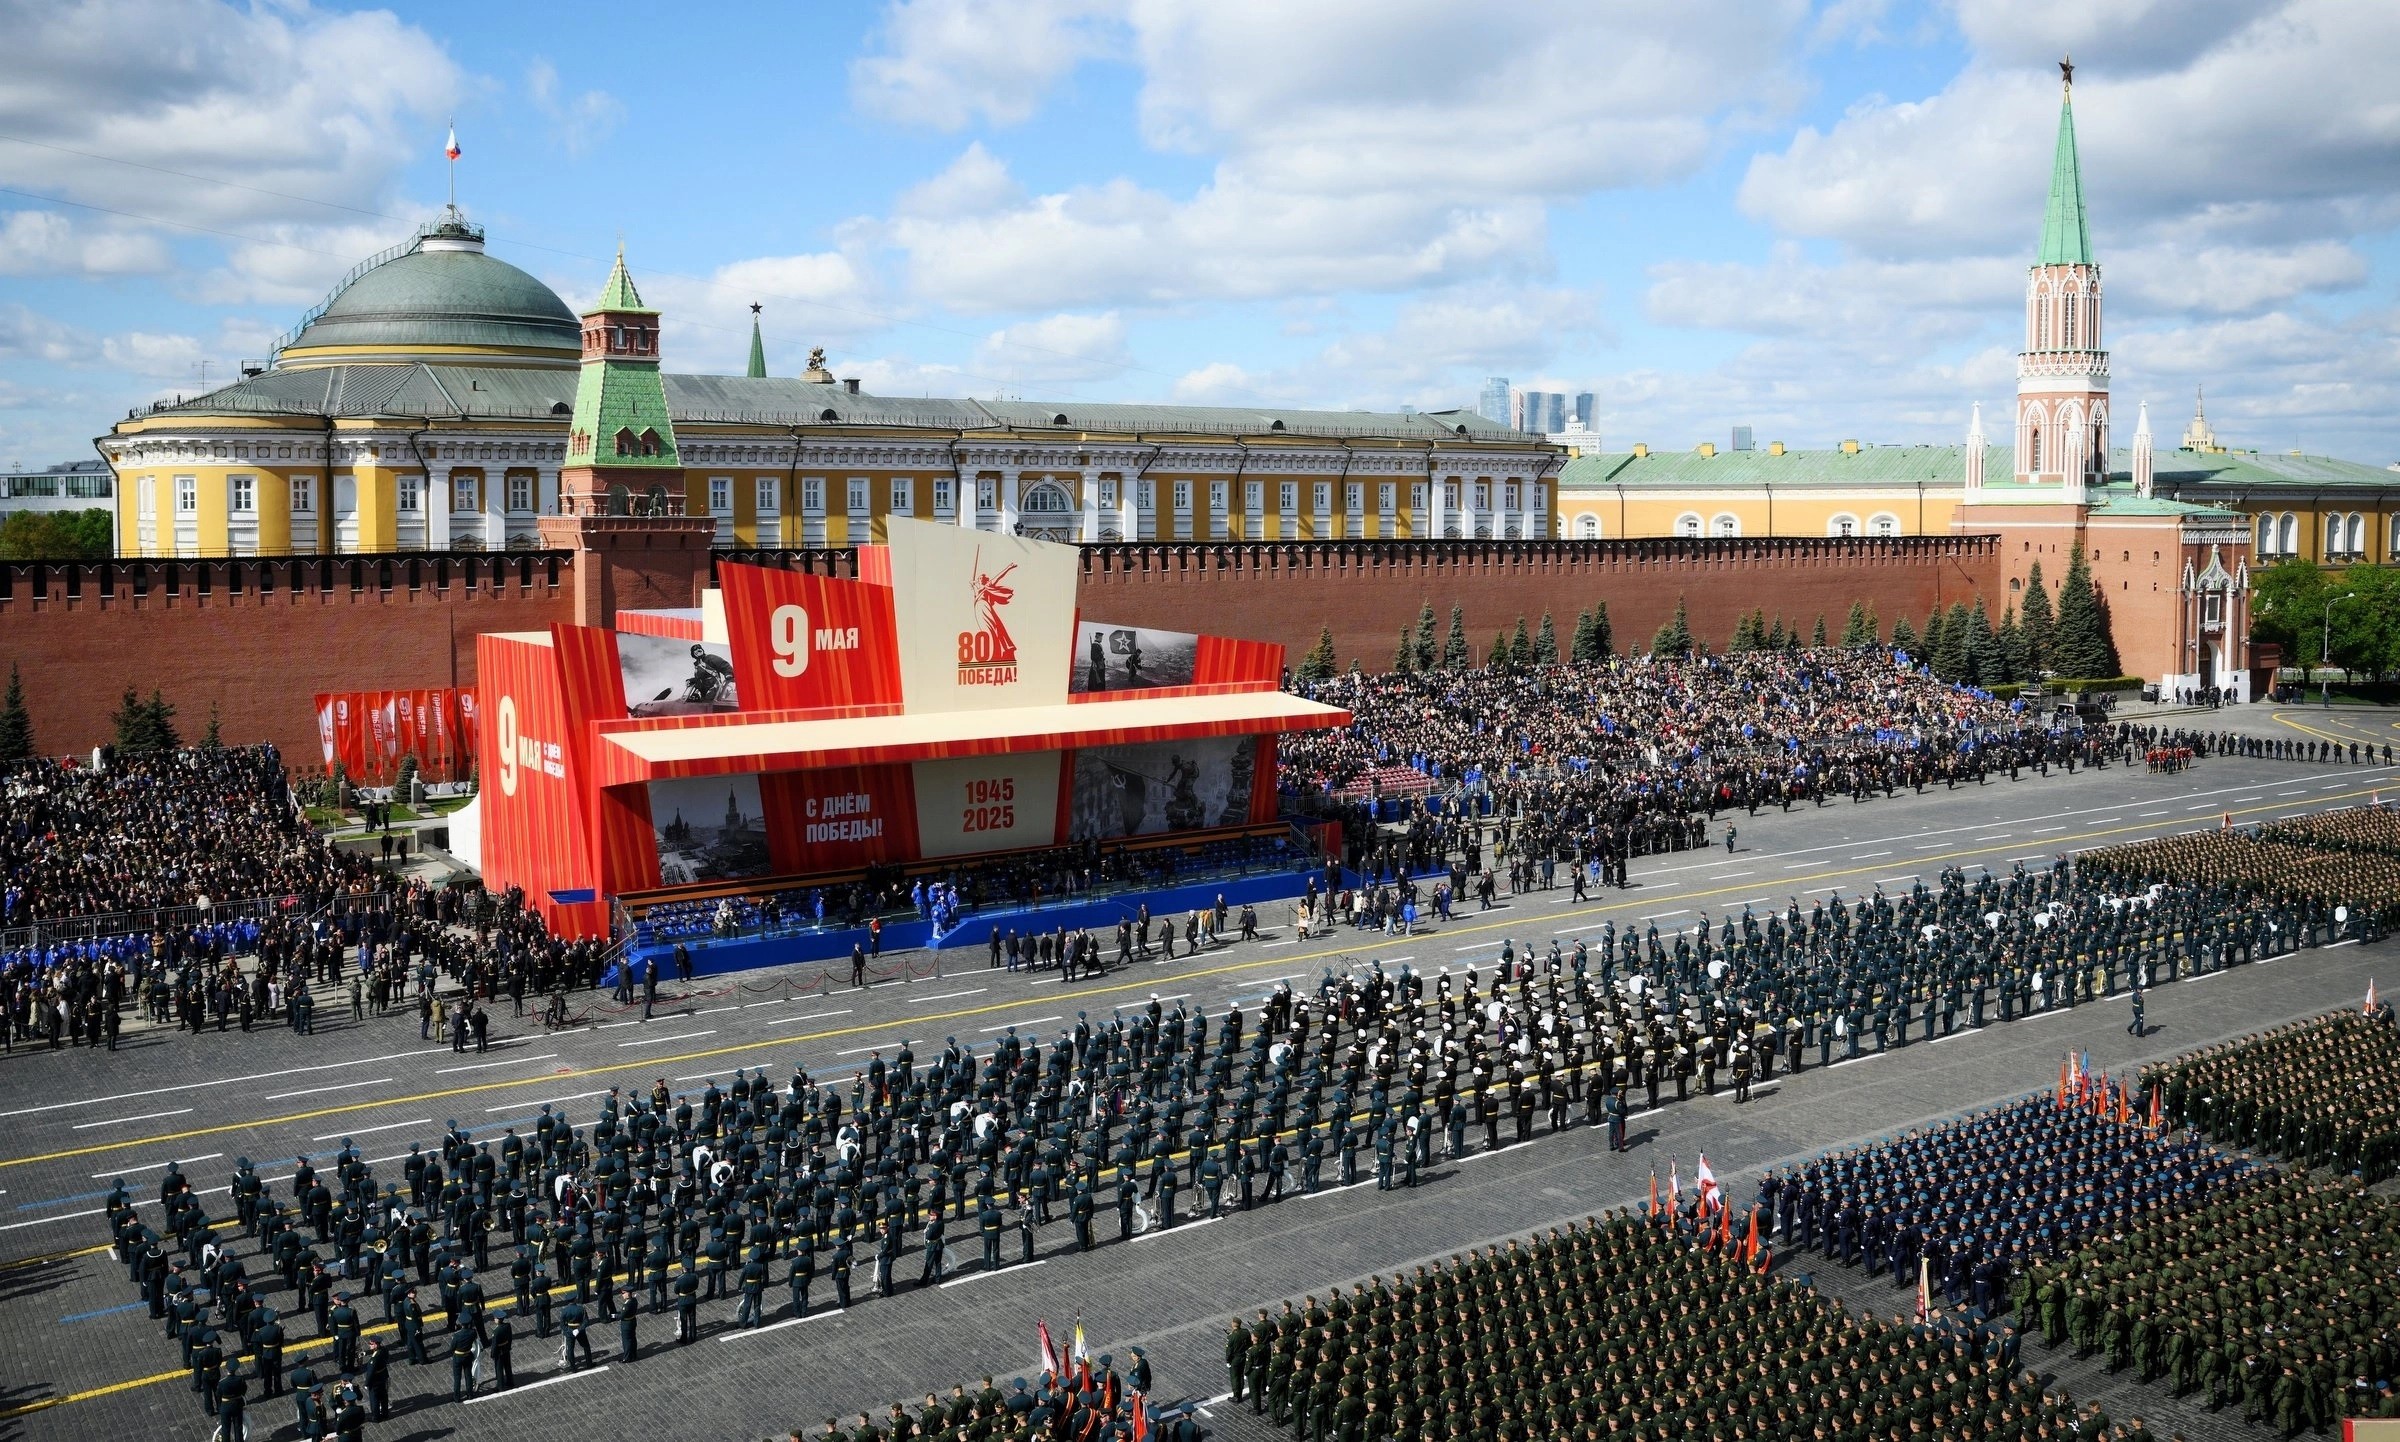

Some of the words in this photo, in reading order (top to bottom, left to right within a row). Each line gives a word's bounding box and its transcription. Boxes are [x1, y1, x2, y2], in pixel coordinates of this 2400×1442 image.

[771, 604, 808, 678] 9
[815, 627, 859, 651] МАЯ
[958, 631, 990, 662] 80
[958, 667, 1017, 686] ПОБЕДА!
[336, 700, 348, 720] 9
[399, 697, 411, 716] 9
[461, 693, 473, 712] 9
[499, 695, 517, 797] 9
[518, 735, 542, 772] МАЯ
[965, 778, 1014, 804] 1945
[806, 798, 817, 818] С
[821, 792, 871, 819] ДНЁМ
[963, 805, 1014, 832] 2025
[806, 818, 883, 843] ПОБЕДЫ!
